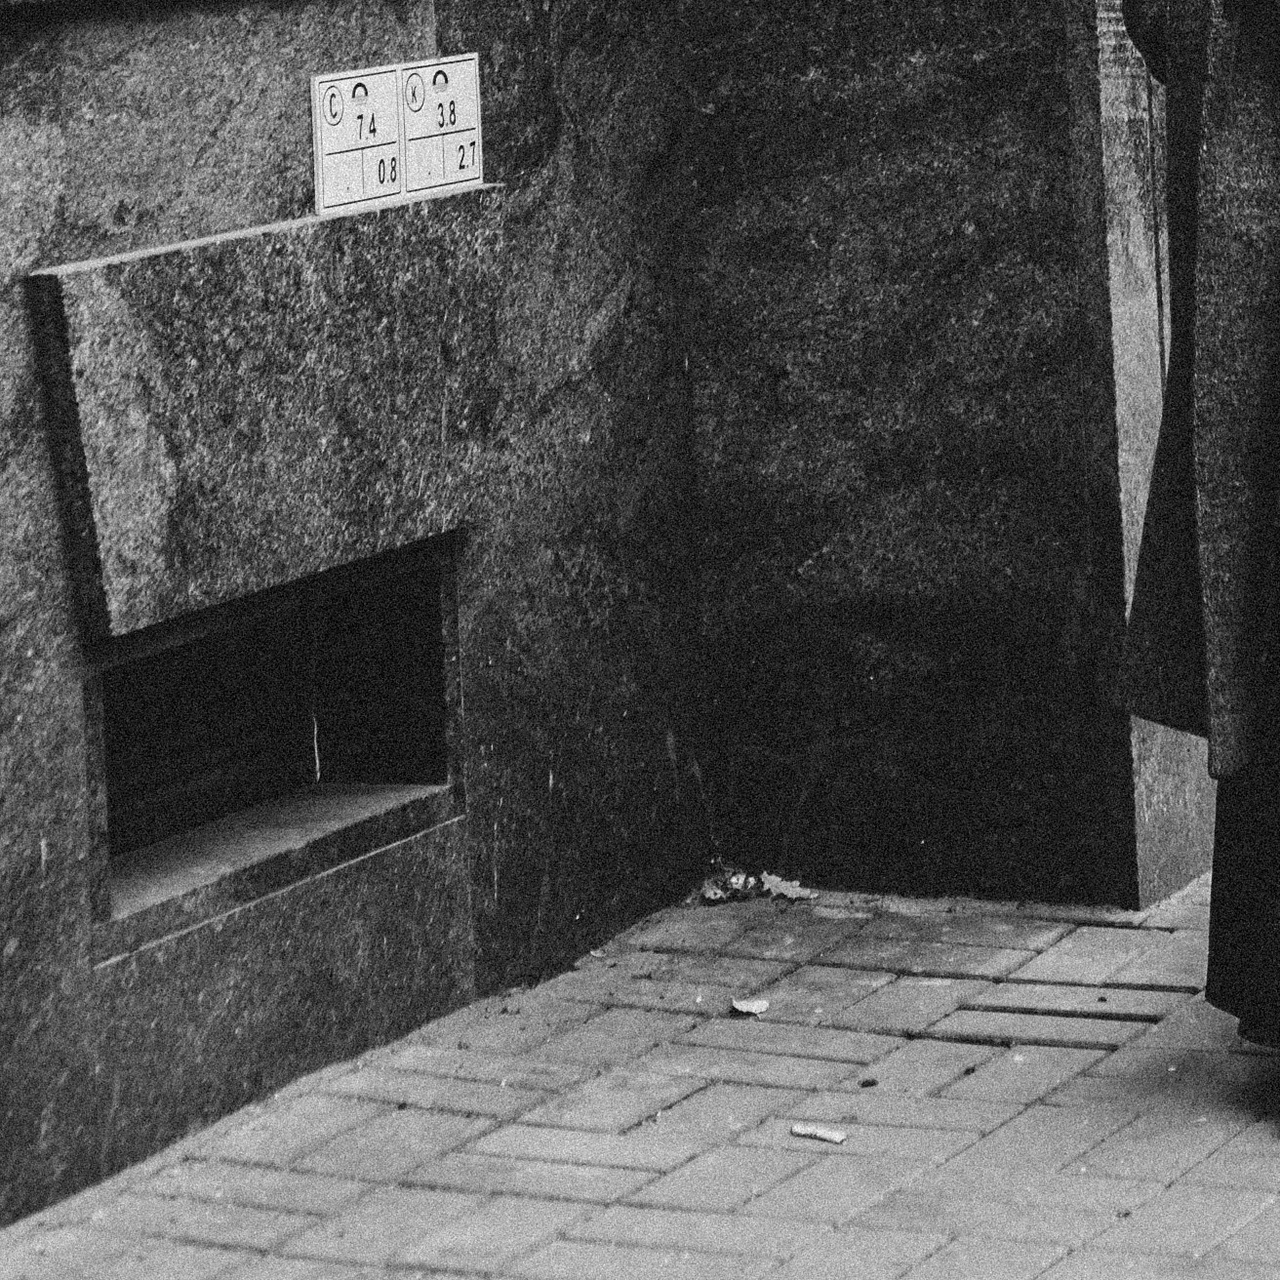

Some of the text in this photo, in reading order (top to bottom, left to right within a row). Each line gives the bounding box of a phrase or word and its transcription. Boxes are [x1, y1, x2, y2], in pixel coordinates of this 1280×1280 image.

[357, 112, 377, 140] 7.4
[437, 100, 457, 129] 3.8
[457, 140, 476, 171] 2.7
[378, 156, 397, 185] 0.8
